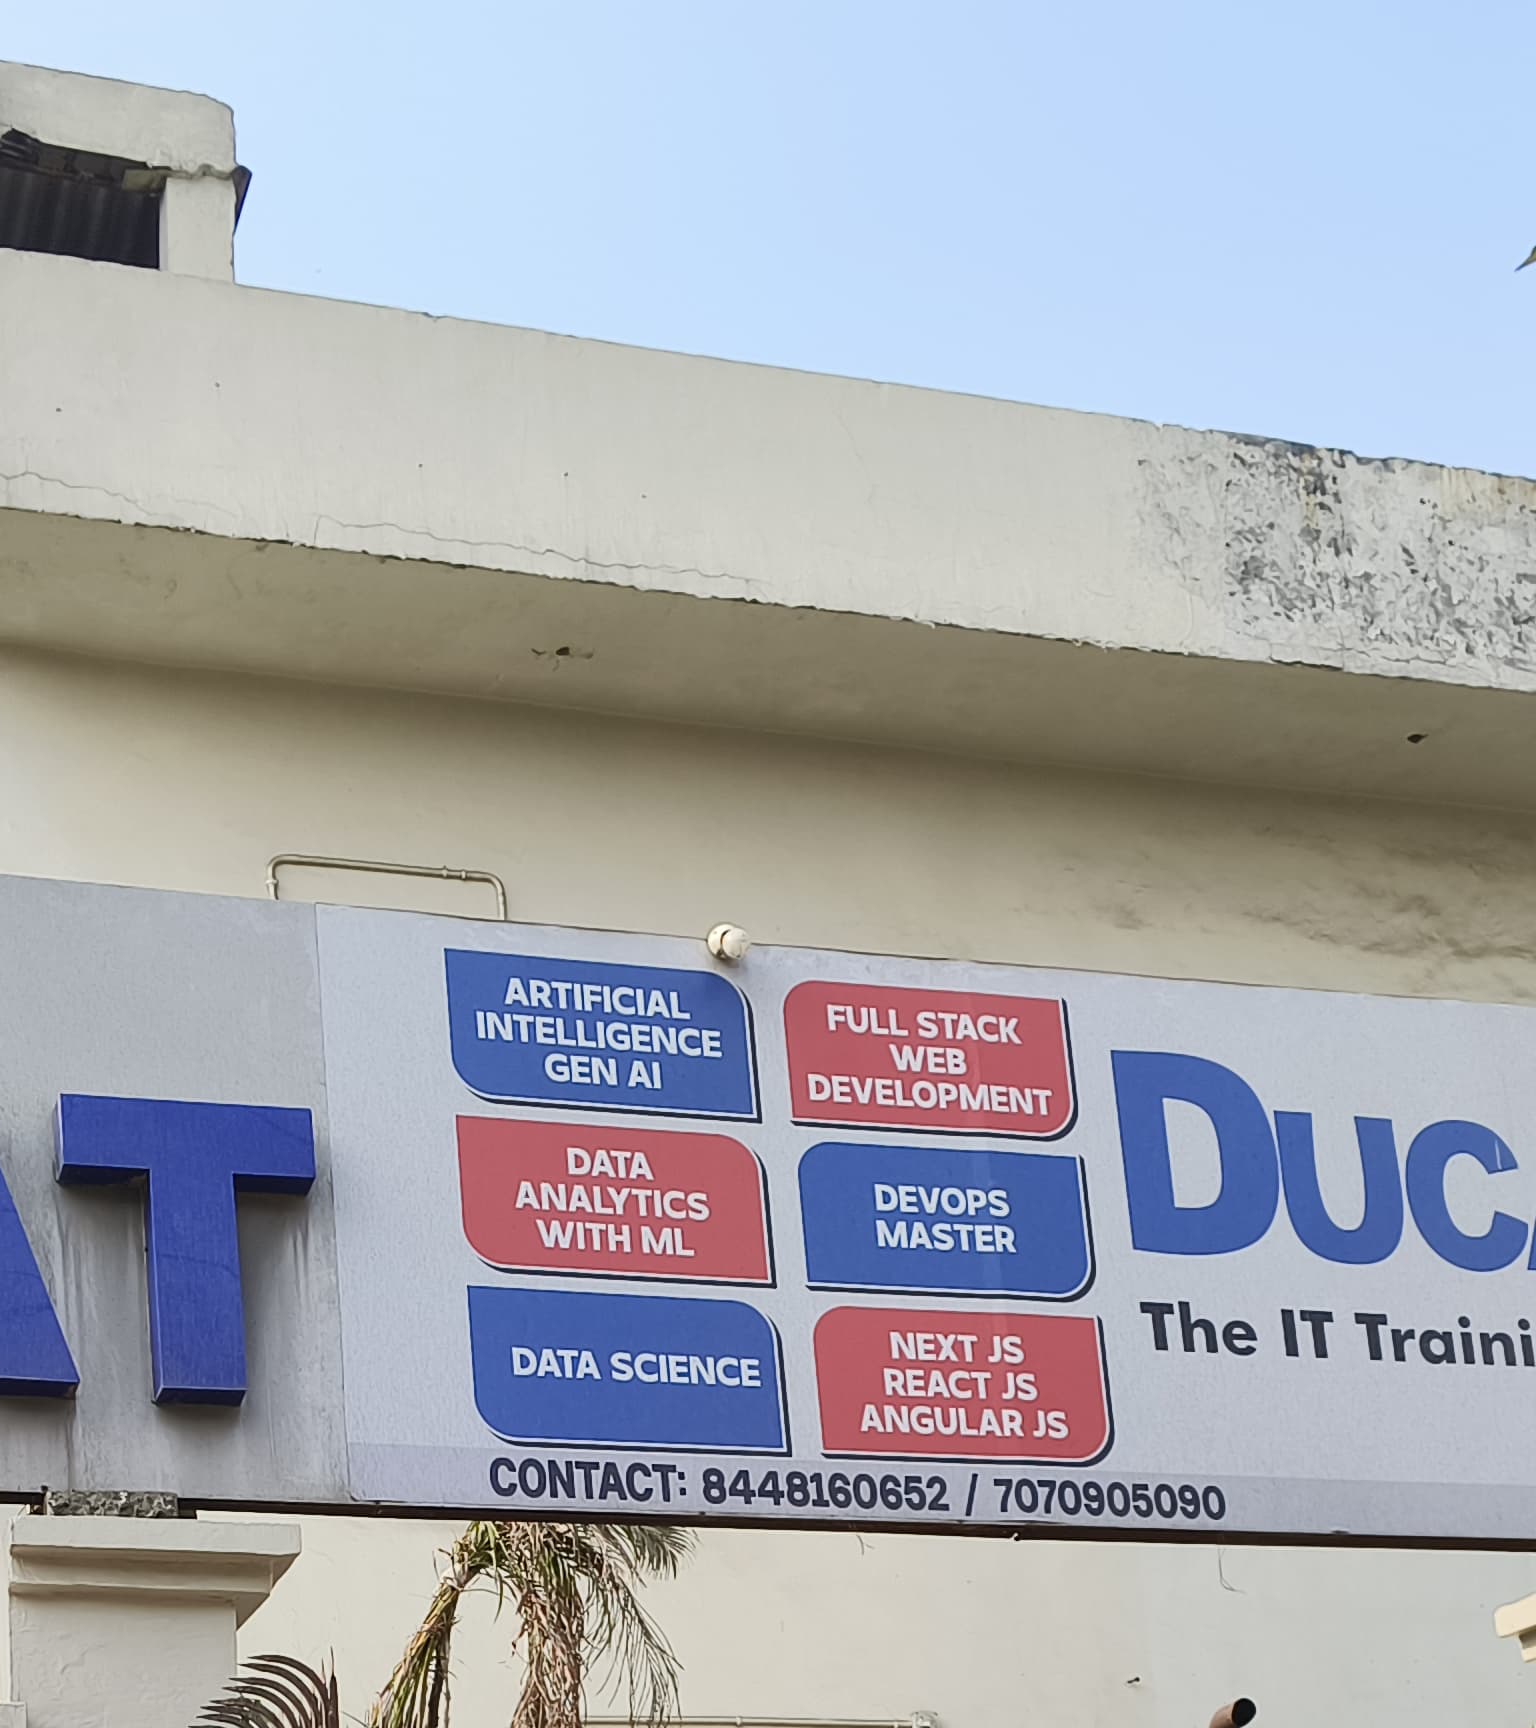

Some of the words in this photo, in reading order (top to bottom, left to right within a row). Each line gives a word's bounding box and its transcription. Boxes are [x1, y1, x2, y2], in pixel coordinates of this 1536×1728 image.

[505, 978, 690, 1019] ARTIFICIAL
[477, 1011, 722, 1057] INTELLIGENCE
[827, 1005, 908, 1037] FULL
[917, 1012, 1021, 1044] STACK
[545, 1054, 617, 1085] GEN
[628, 1061, 661, 1088] AI
[890, 1044, 966, 1075] WEB
[808, 1074, 1052, 1115] DEVELOPMENT
[567, 1148, 654, 1180] DATA
[516, 1182, 709, 1221] ANALYTICS
[875, 1184, 1009, 1217] DEVOPS
[537, 1220, 631, 1252] WITH
[641, 1226, 694, 1256] ML
[876, 1220, 1016, 1252] MASTER
[1140, 1301, 1257, 1355] The
[1281, 1309, 1333, 1358] IT
[890, 1332, 977, 1362] NEXT
[989, 1336, 1024, 1364] JS
[512, 1347, 601, 1379] DATA
[611, 1352, 761, 1386] SCIENCE
[884, 1368, 991, 1399] REACT
[1002, 1373, 1037, 1401] JS
[862, 1404, 1024, 1437] ANGULAR
[1033, 1411, 1068, 1439] JS
[490, 1458, 686, 1502] CONTACT:
[703, 1468, 949, 1514] 8448160652
[965, 1473, 978, 1516] /
[993, 1479, 1227, 1520] 7070905090
